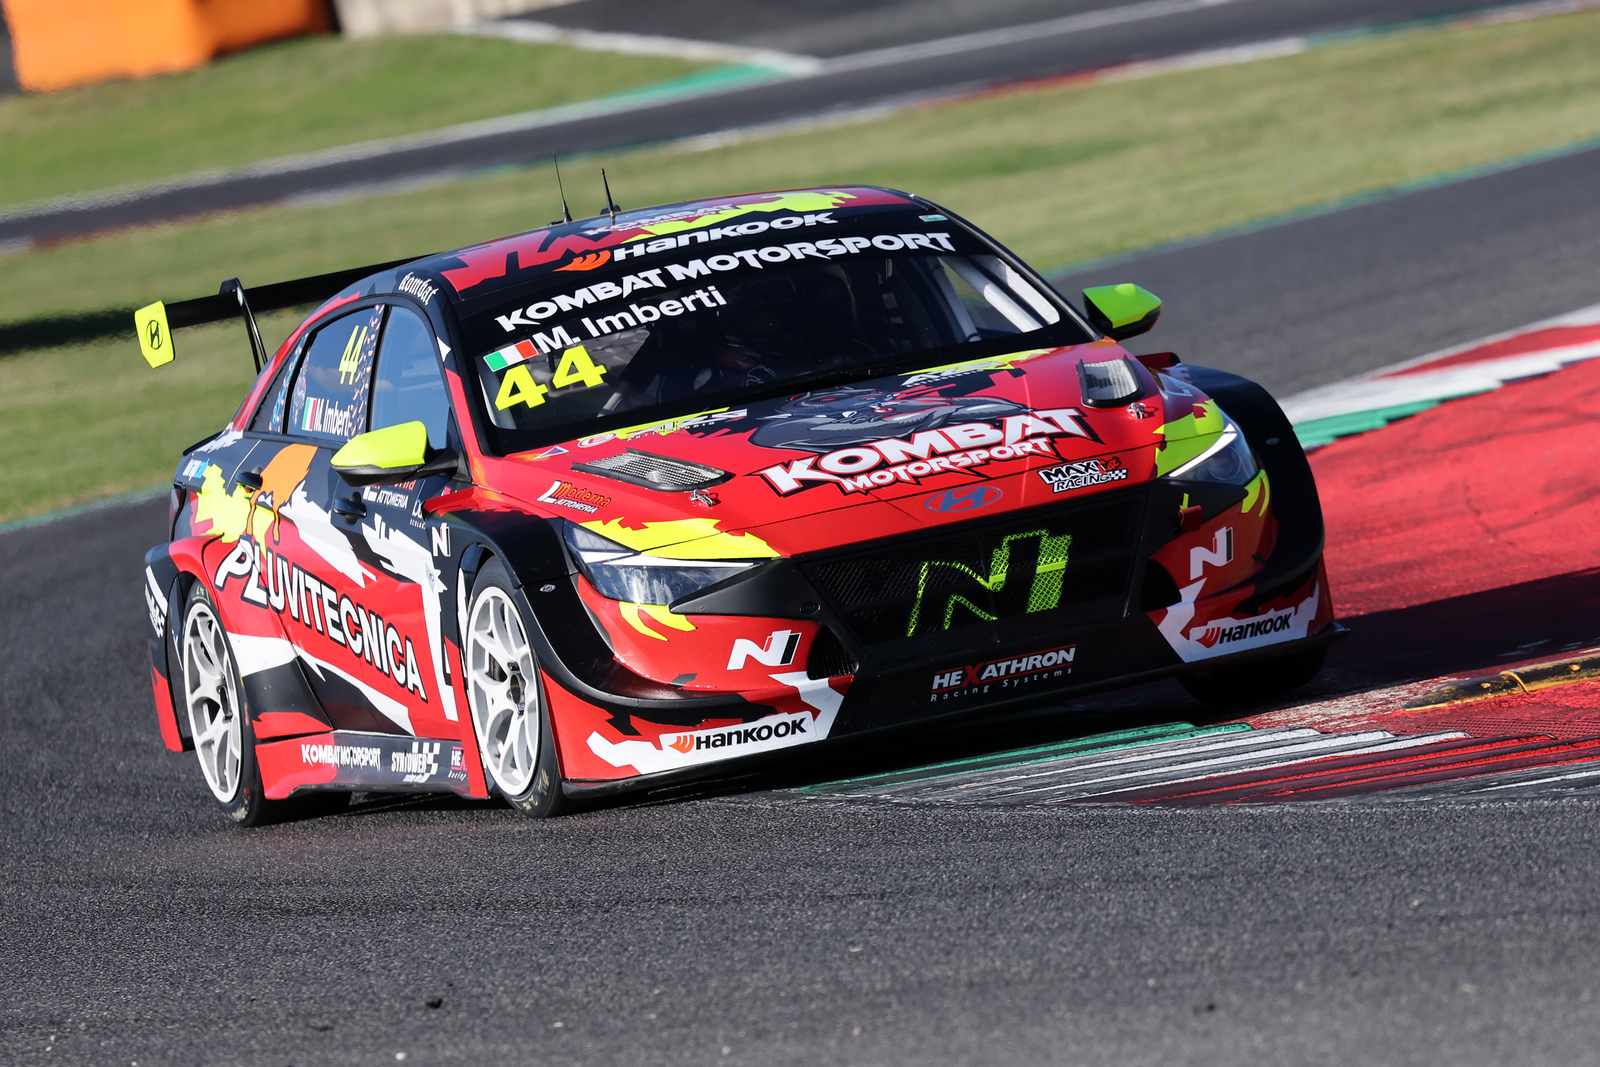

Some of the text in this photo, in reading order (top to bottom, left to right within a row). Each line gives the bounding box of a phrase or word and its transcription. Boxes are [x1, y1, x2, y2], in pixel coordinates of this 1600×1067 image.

[495, 232, 956, 332] KOMBAT MOTORSPORT
[533, 285, 727, 355] M. Imberti
[338, 325, 368, 385] 44
[494, 344, 608, 412] 44
[763, 409, 1093, 493] KOMBAT
[841, 436, 1064, 493] MOTORSPORT
[1053, 473, 1112, 493] RACING
[214, 537, 428, 703] PLUVITECNICA
[931, 669, 1074, 702] Racing Systems
[932, 647, 1076, 691] HEXATHRON
[301, 744, 341, 768] KOMBAT
